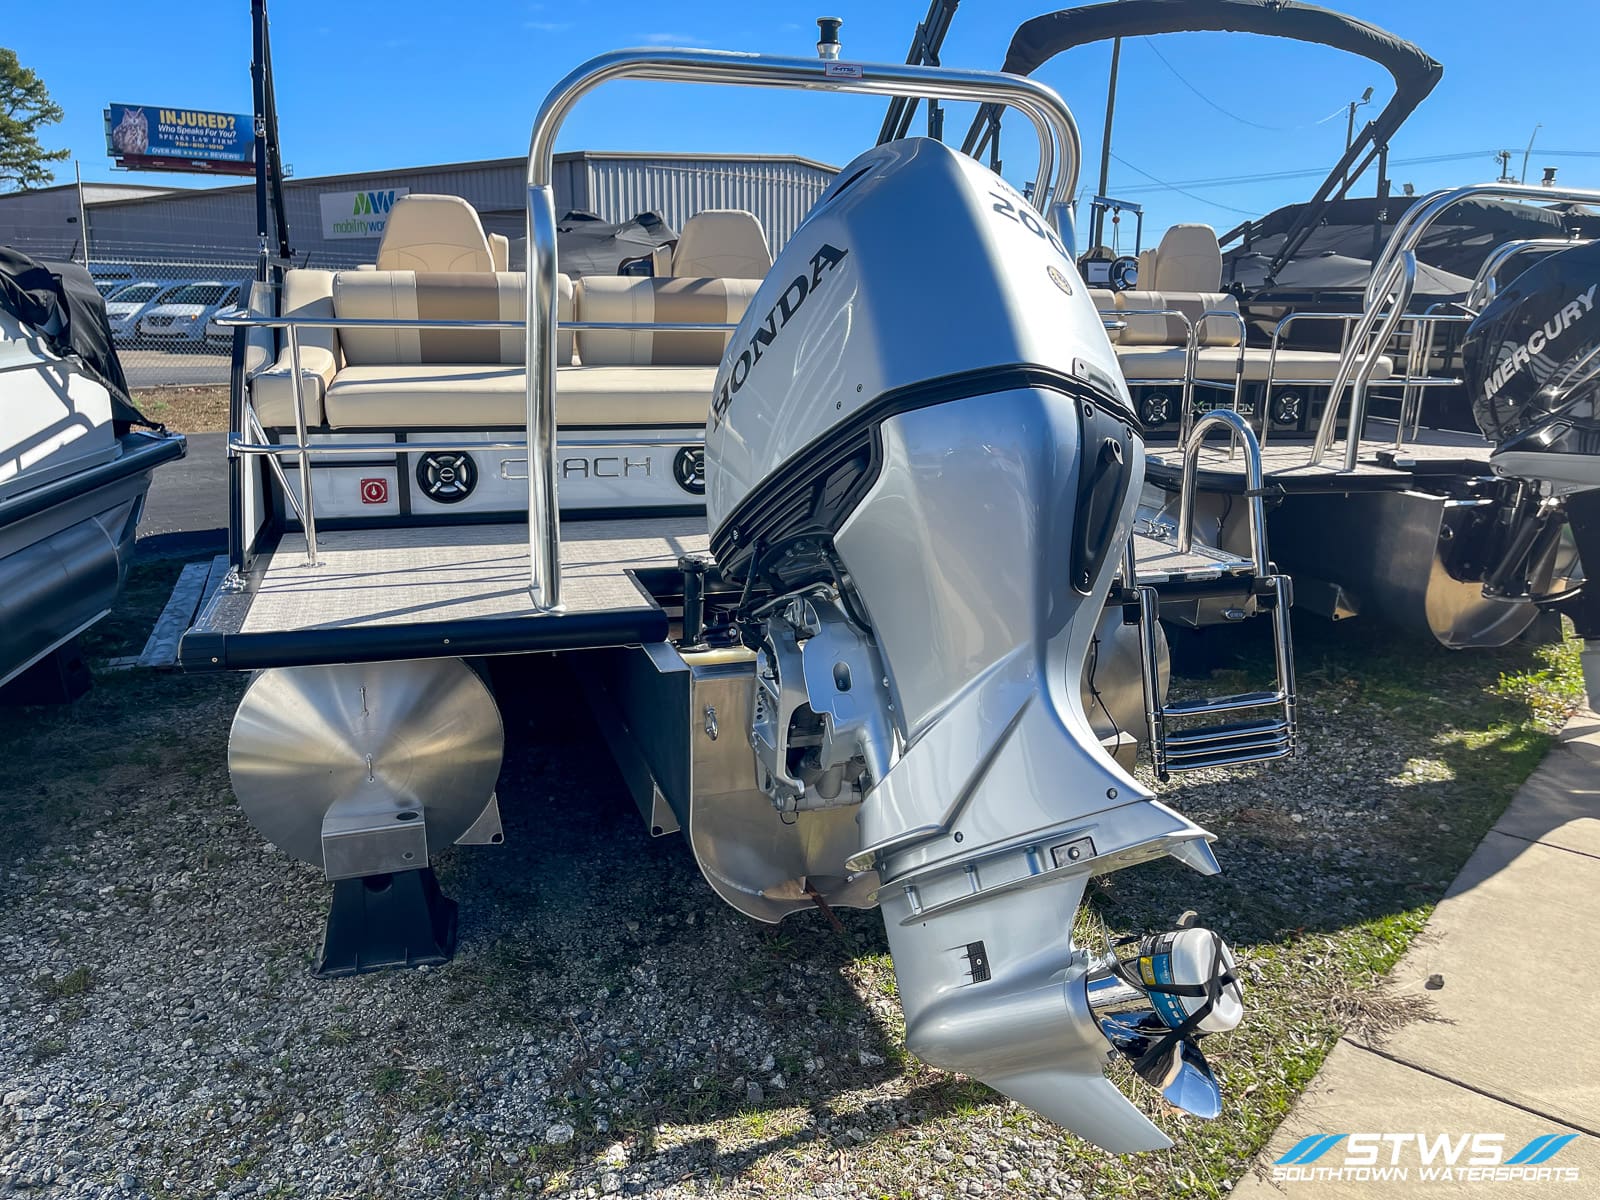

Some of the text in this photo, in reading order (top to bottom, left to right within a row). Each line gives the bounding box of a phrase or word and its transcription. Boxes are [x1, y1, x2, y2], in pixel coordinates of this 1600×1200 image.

[159, 109, 236, 130] INJURED?
[158, 124, 237, 138] Who Speaks For You?
[333, 219, 386, 237] mobilitywor
[713, 243, 849, 433] HONDA
[1483, 283, 1598, 401] MERCURY
[500, 456, 651, 480] CACH
